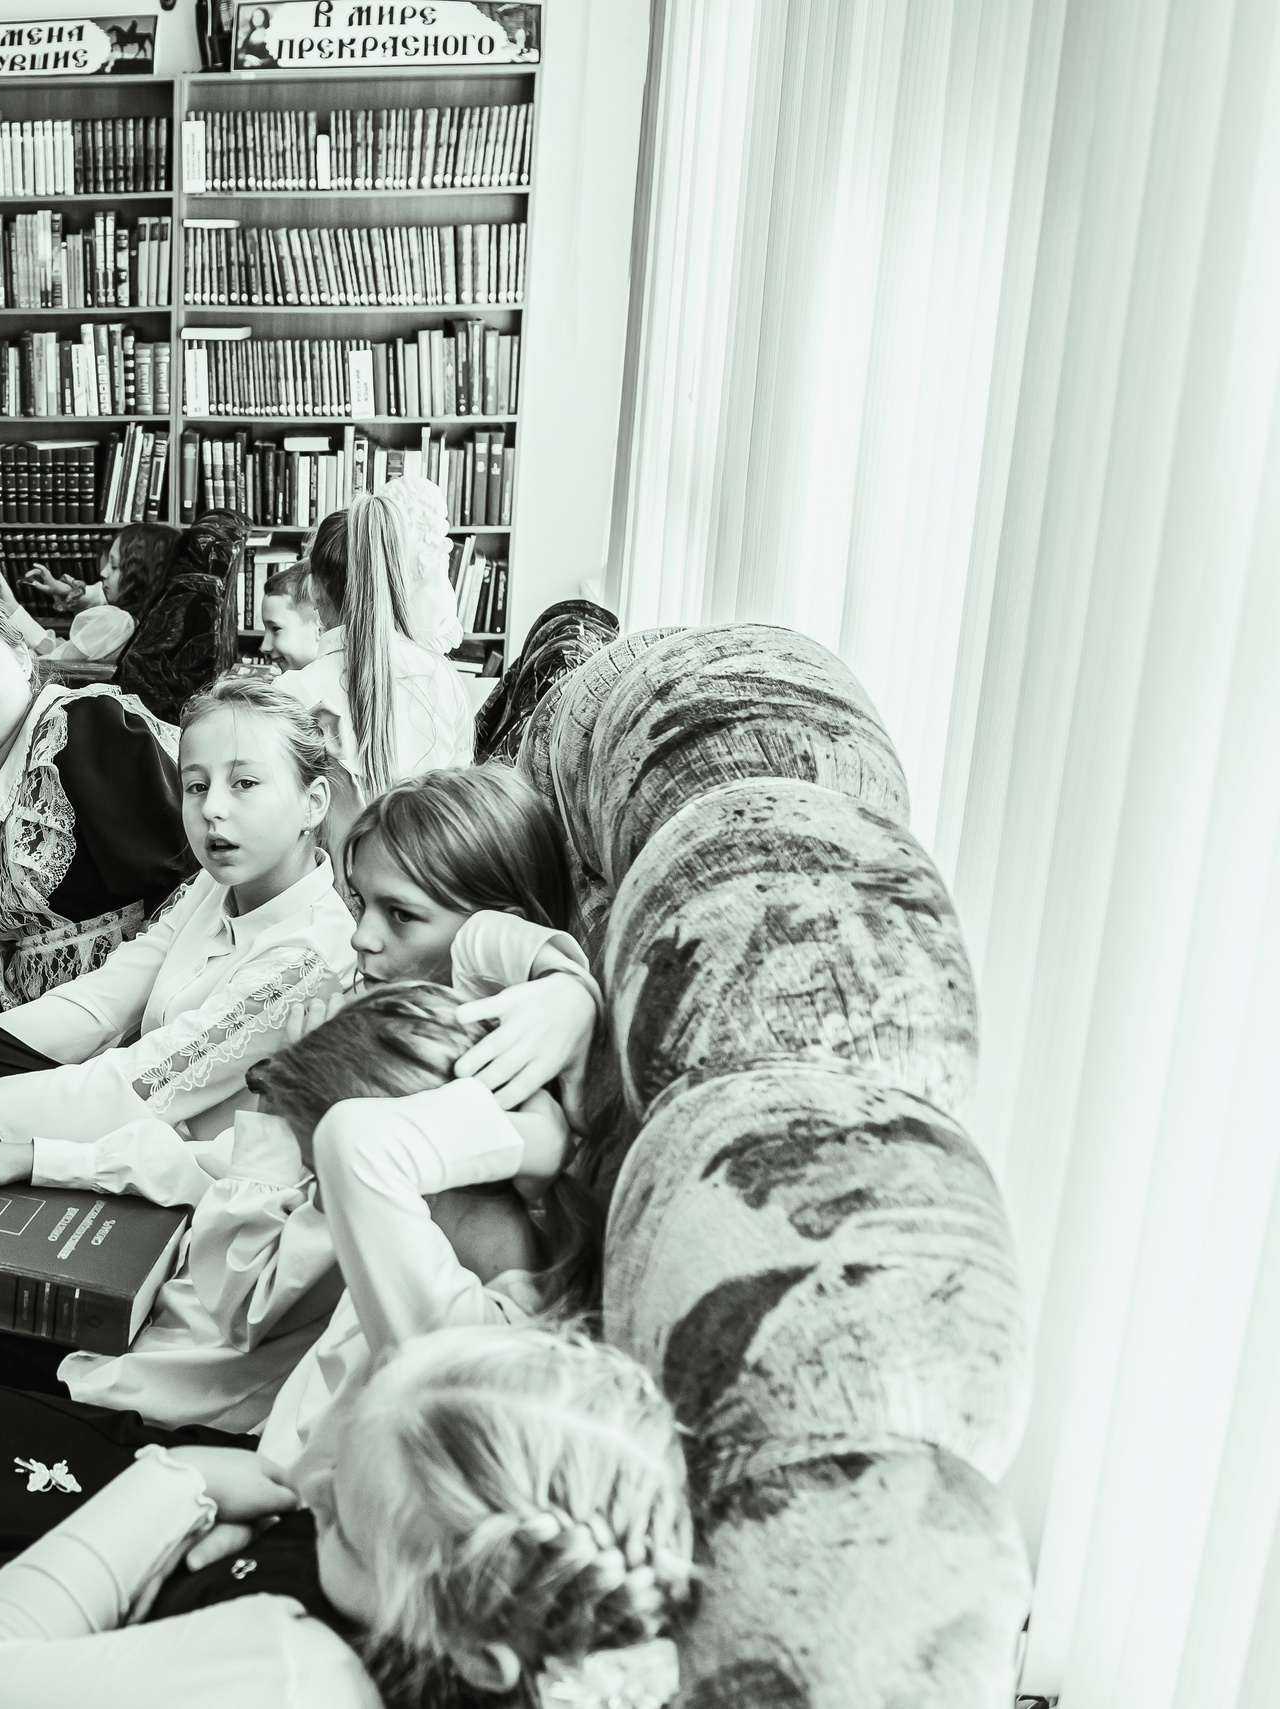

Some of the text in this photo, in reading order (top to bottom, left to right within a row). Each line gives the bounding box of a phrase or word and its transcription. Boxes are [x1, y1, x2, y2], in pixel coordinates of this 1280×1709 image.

[313, 0, 438, 28] В МИРЕ
[277, 34, 495, 60] ПРЕКРАСНОГО
